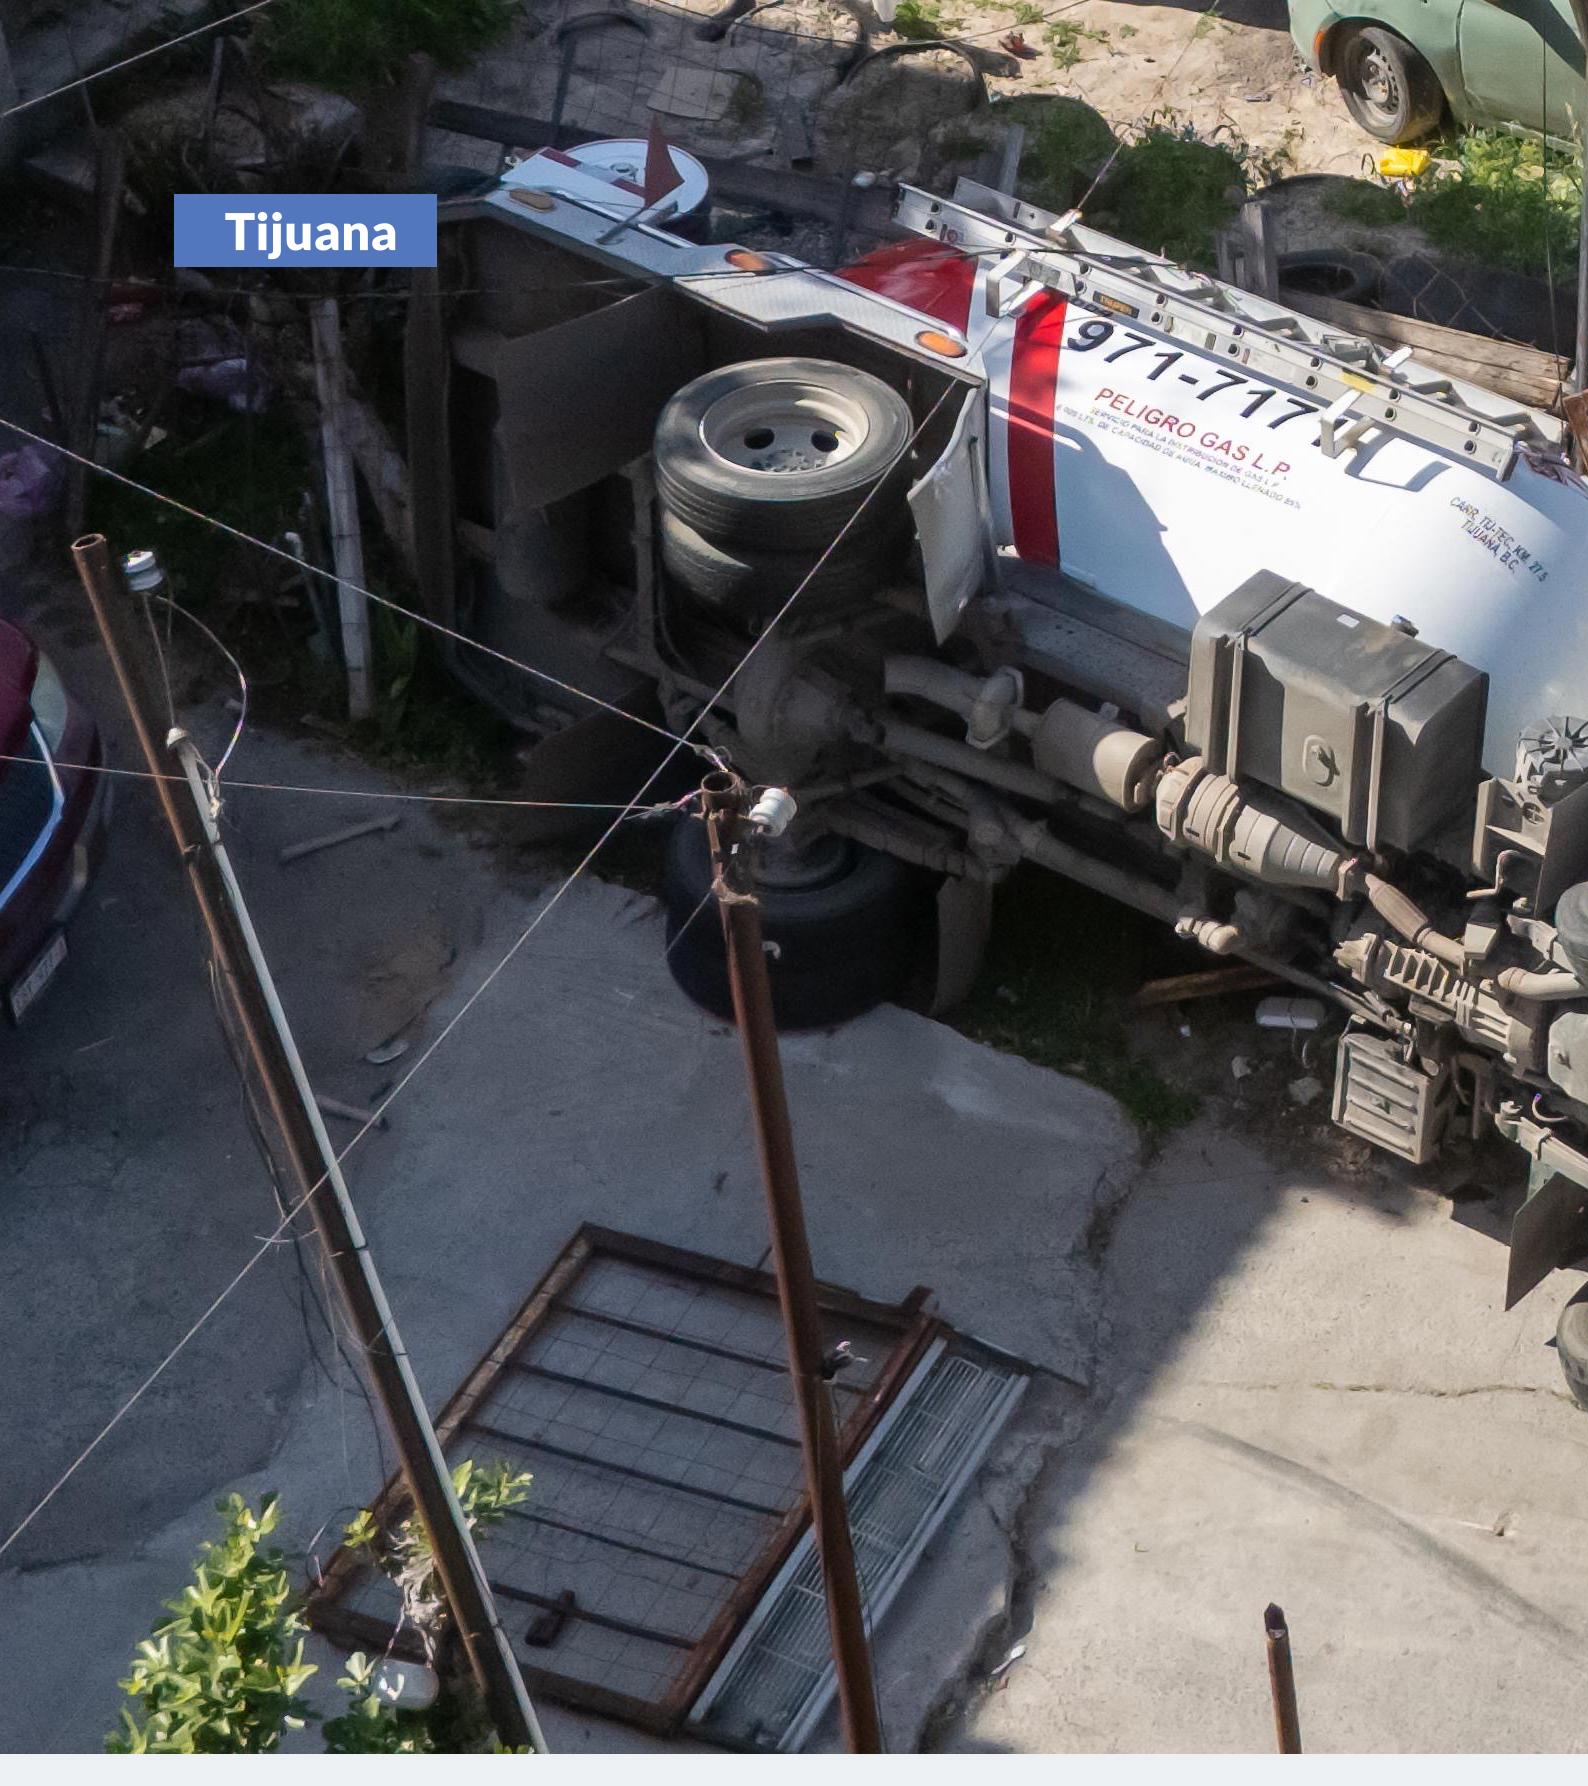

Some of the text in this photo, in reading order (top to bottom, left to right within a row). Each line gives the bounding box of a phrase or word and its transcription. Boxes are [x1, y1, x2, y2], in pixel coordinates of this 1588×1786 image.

[1094, 388, 1196, 438] PELIGRO
[1200, 431, 1250, 461] GAS
[1251, 453, 1290, 480] L.P.
